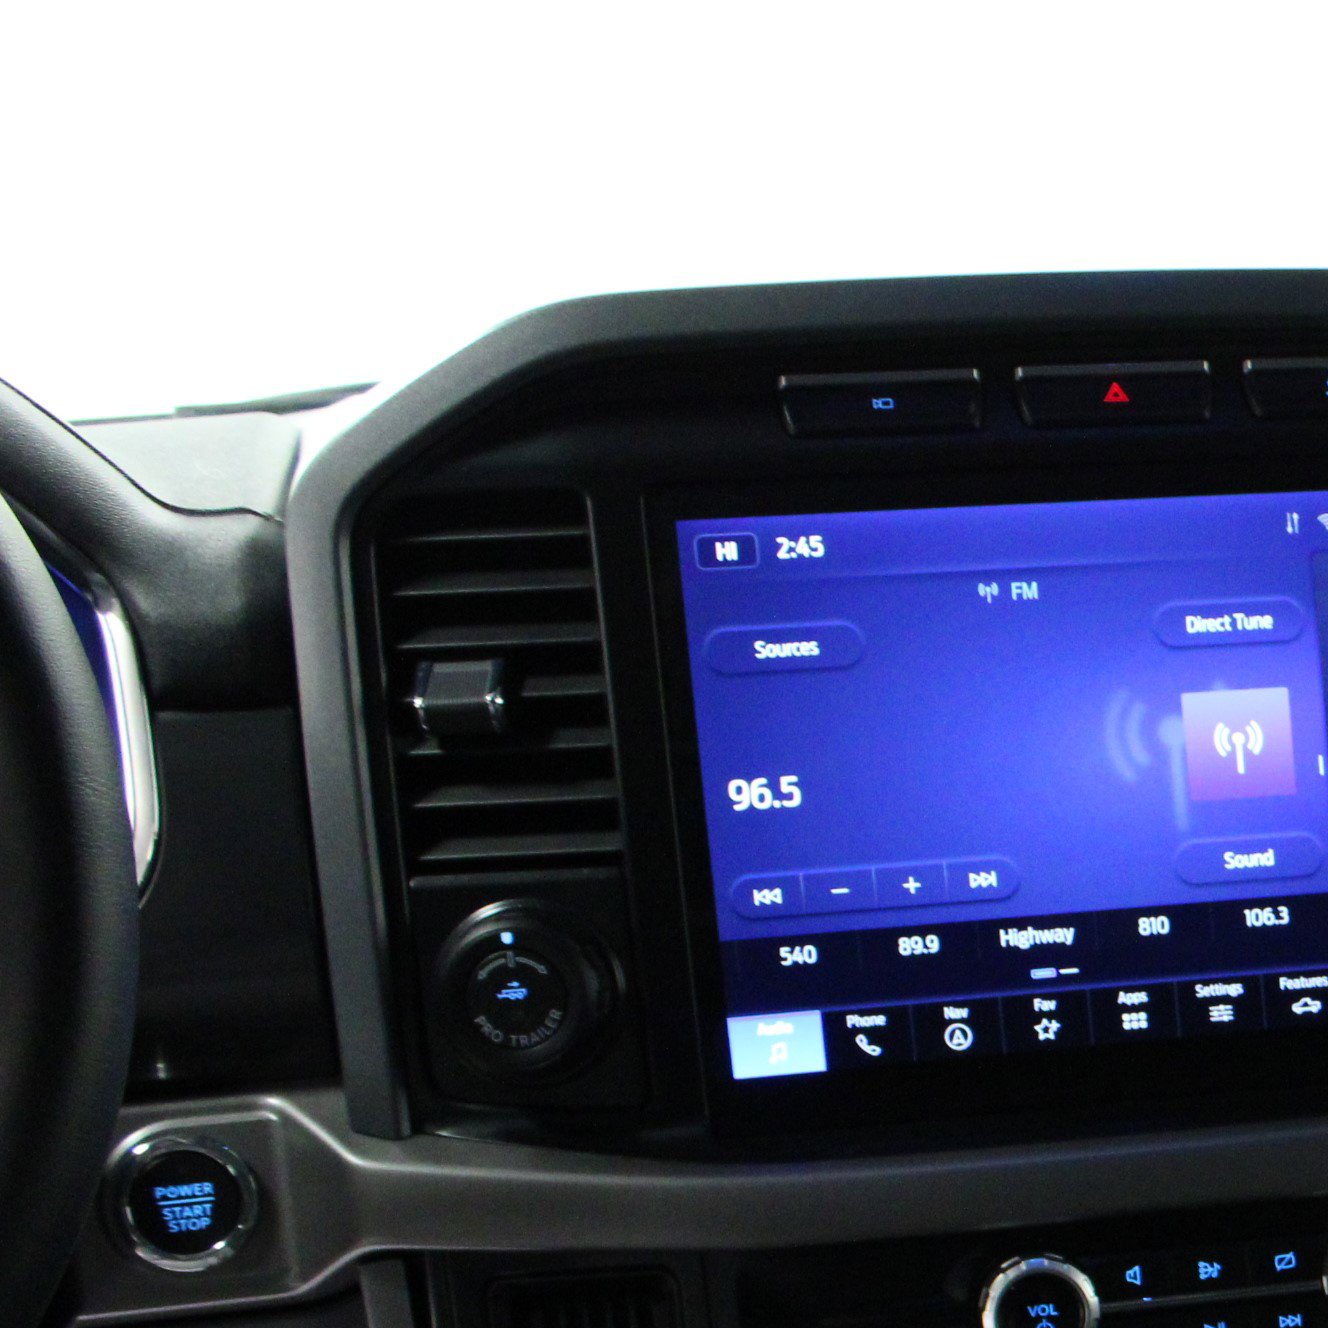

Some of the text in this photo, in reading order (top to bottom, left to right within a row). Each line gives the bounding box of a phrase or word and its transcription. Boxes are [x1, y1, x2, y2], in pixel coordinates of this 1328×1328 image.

[714, 540, 739, 562] HI
[775, 534, 826, 560] 2:45
[1010, 581, 1039, 601] FM
[1185, 612, 1274, 634] Direct Tune
[753, 640, 821, 660] Sources
[727, 774, 803, 812] 96.5
[1223, 848, 1276, 870] Sound
[1137, 915, 1171, 937] 810
[1243, 905, 1290, 928] 106.3
[897, 934, 940, 957] 89.9
[999, 926, 1075, 950] Highway
[779, 944, 818, 967] 540
[1117, 990, 1149, 1006] Apps
[1194, 982, 1244, 998] Settings
[943, 1006, 969, 1020] Nav
[1033, 997, 1057, 1012] Fav
[845, 1014, 887, 1029] Phone
[154, 1182, 215, 1199] POWER
[162, 1204, 212, 1219] START
[167, 1218, 212, 1233] STOP
[1027, 1304, 1058, 1317] VOL
